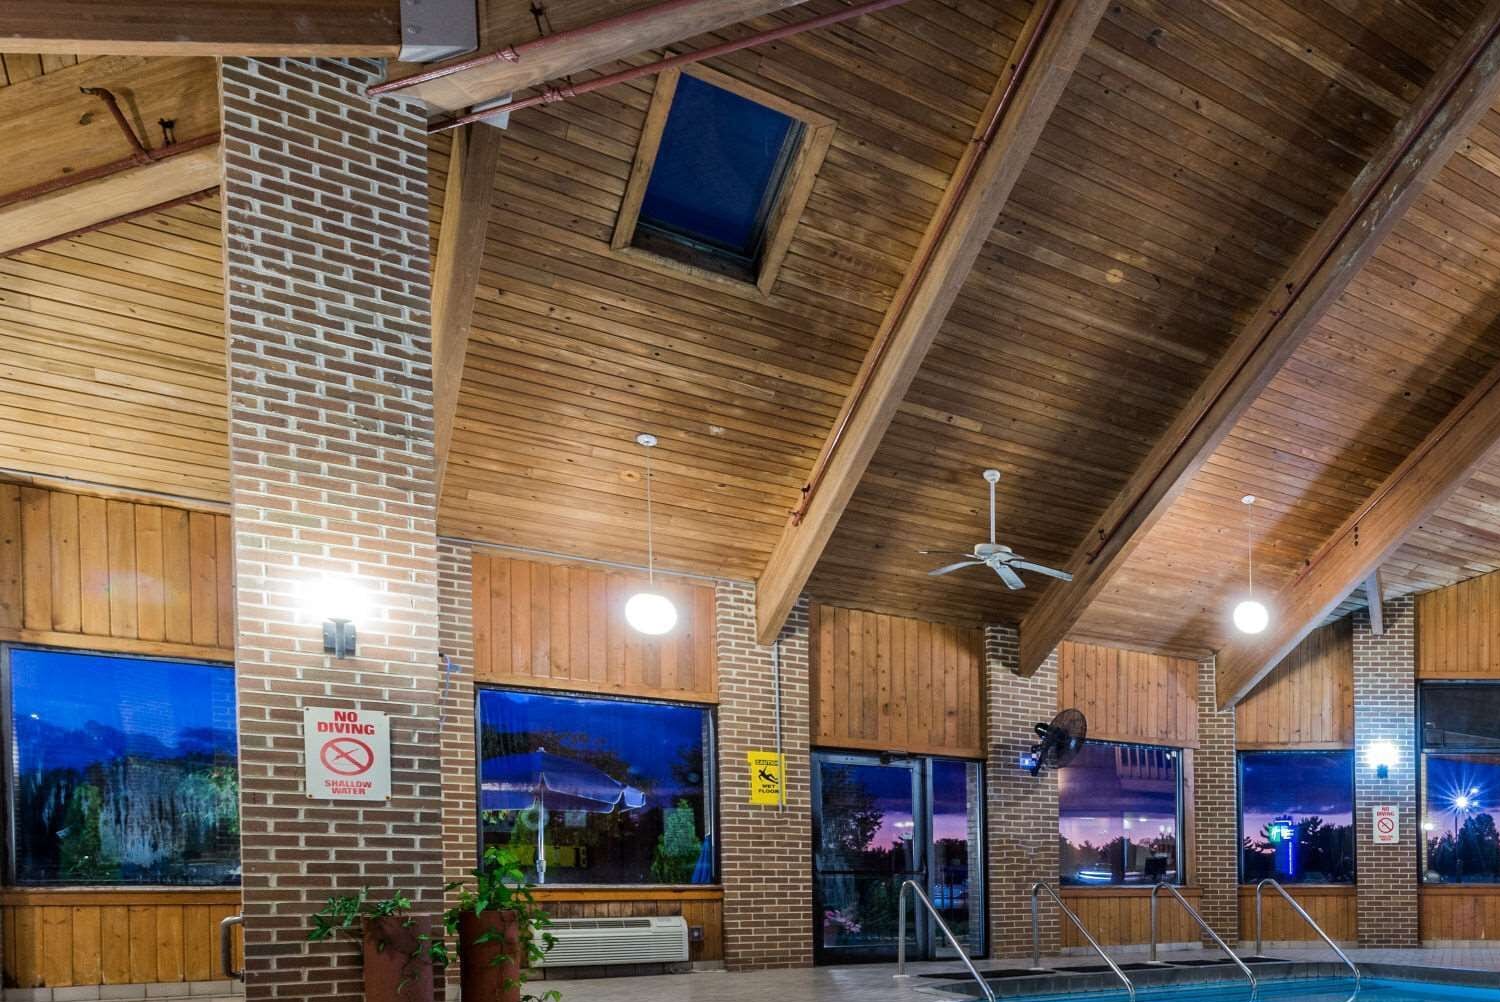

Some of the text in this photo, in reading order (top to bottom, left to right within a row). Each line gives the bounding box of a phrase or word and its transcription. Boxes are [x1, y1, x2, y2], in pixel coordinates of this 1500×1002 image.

[334, 710, 358, 722] NO
[317, 721, 375, 735] DIVING
[324, 780, 372, 788] SHALLOW
[332, 787, 366, 795] WATER
